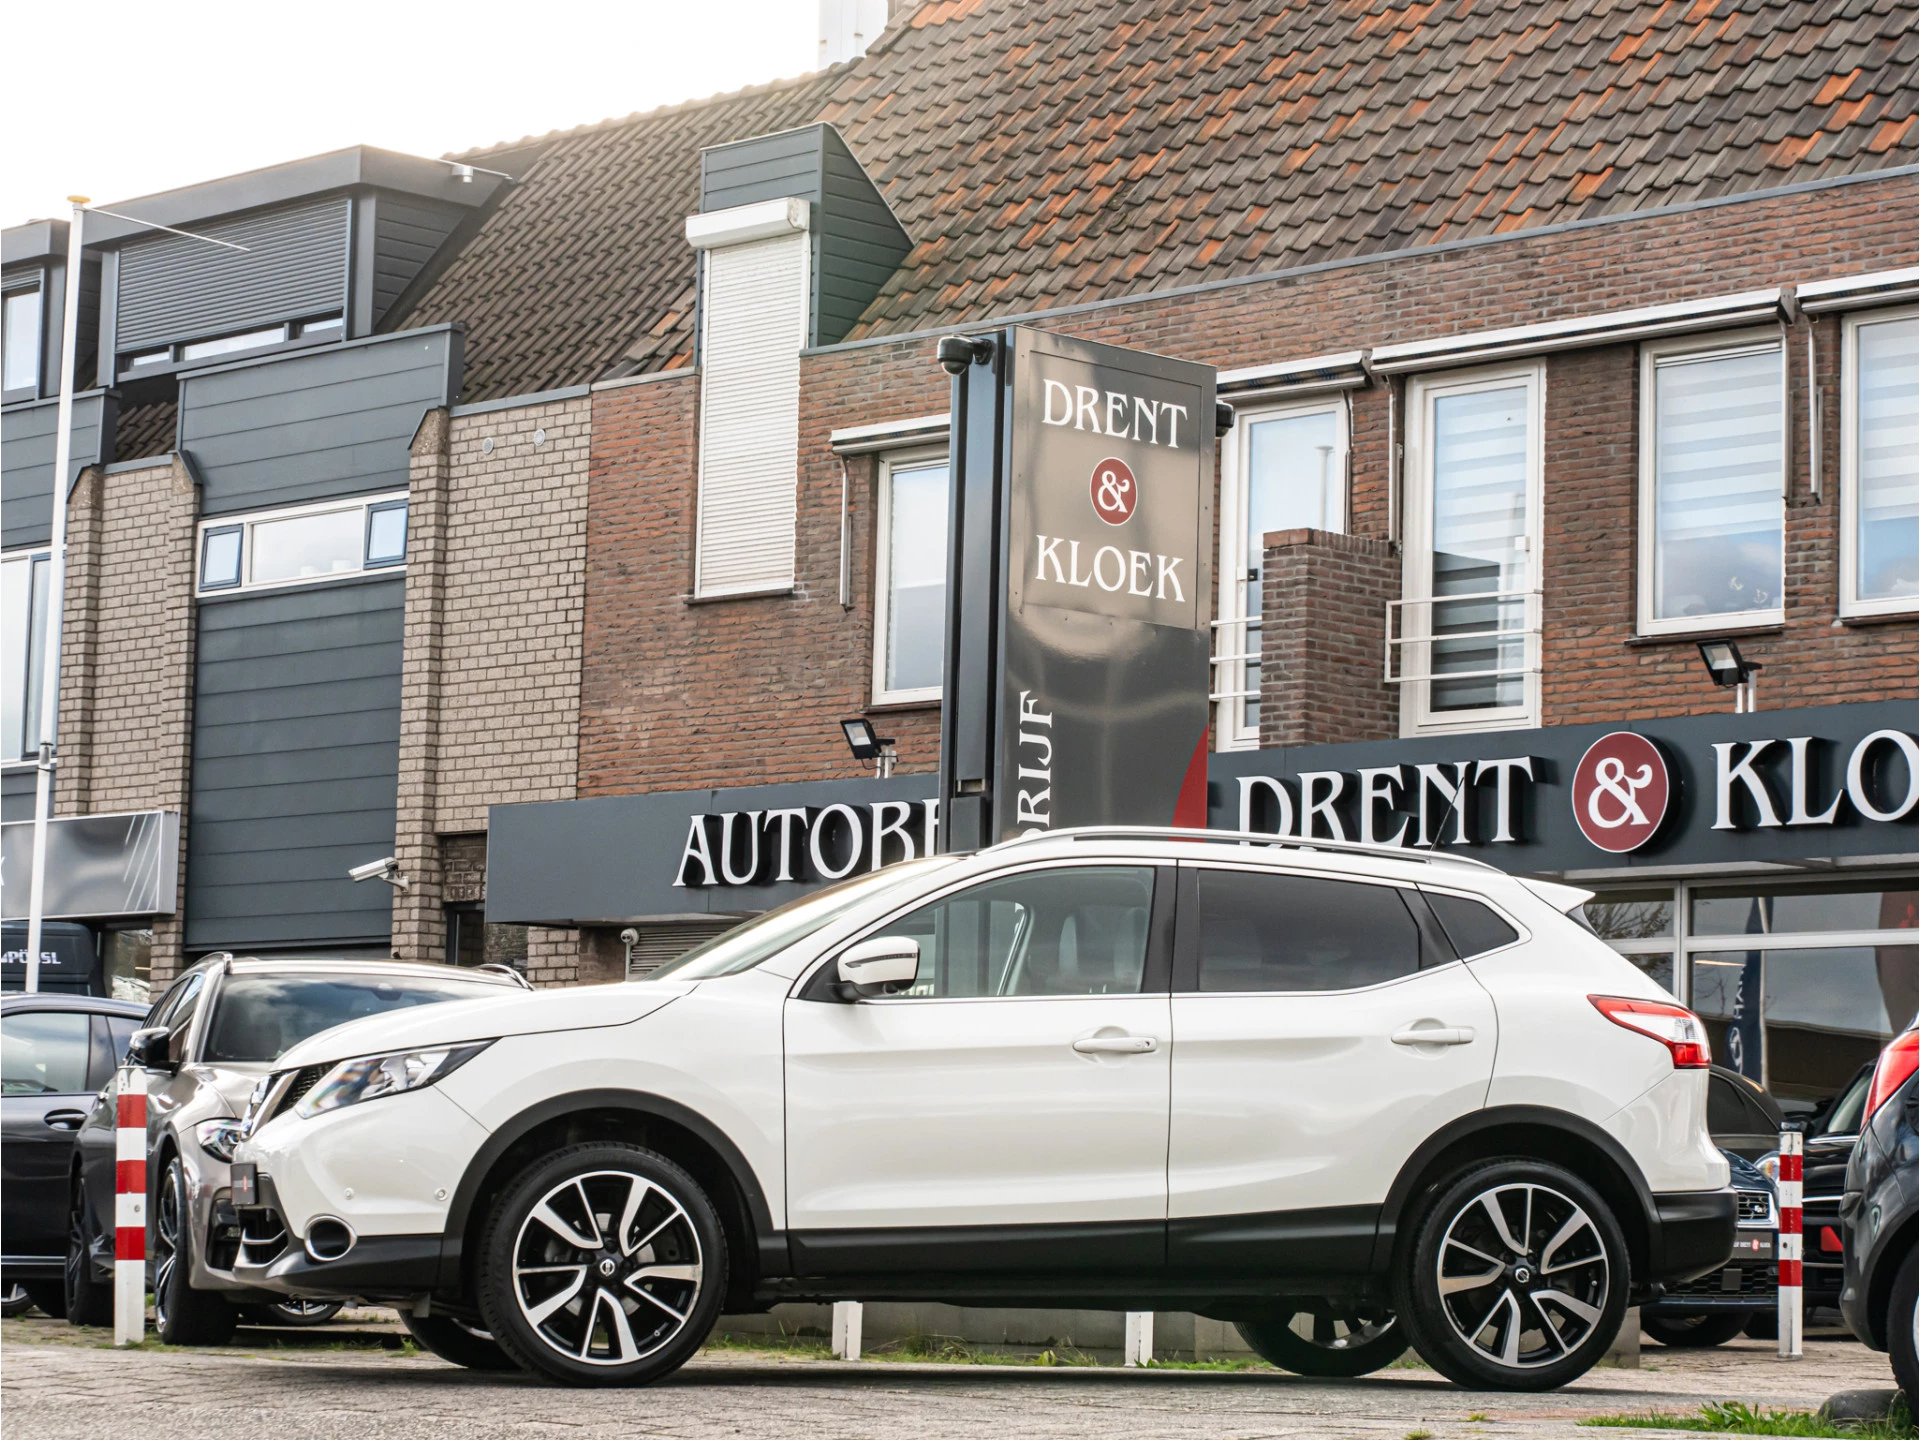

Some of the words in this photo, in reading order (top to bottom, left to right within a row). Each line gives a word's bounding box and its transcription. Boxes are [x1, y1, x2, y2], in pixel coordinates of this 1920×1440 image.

[1041, 378, 1188, 448] DRENT
[1097, 470, 1130, 513] &
[1035, 534, 1186, 603] KLOEK
[1017, 689, 1053, 836] RIJF
[1236, 755, 1535, 852] DRENT
[1588, 757, 1653, 828] &
[8, 948, 62, 965] PÖSL
